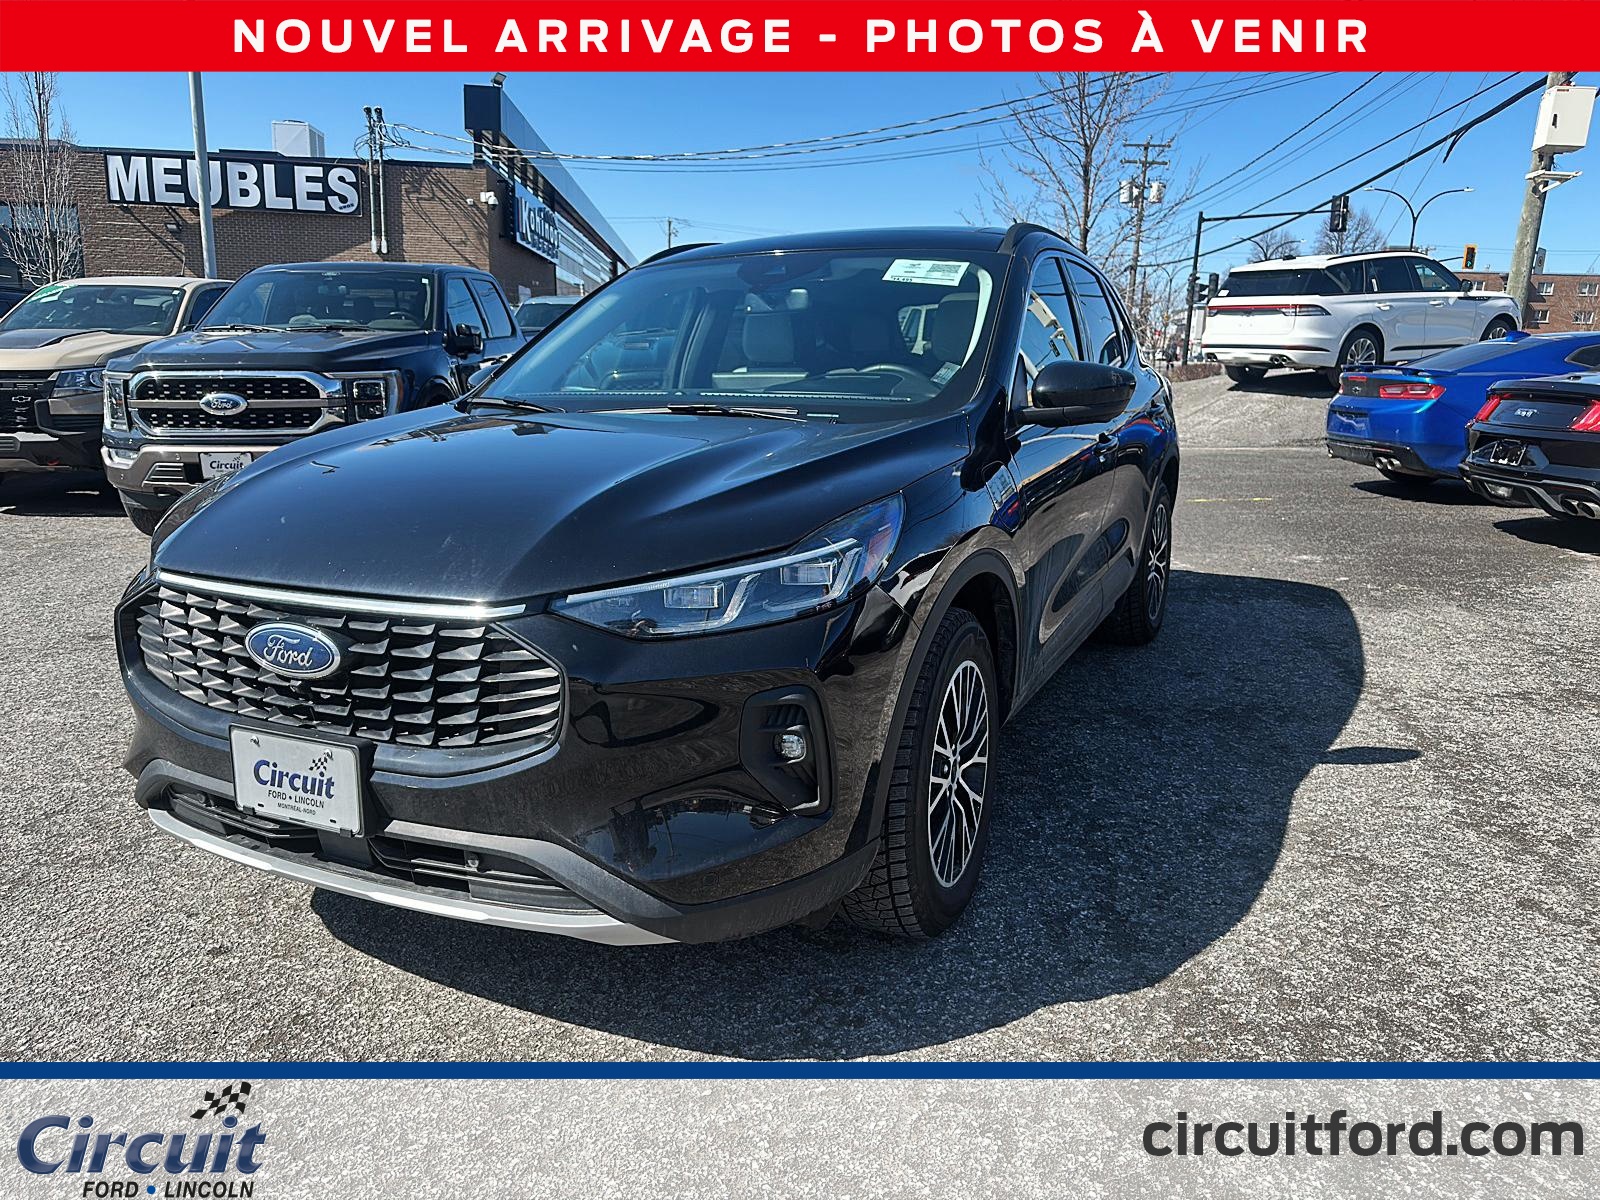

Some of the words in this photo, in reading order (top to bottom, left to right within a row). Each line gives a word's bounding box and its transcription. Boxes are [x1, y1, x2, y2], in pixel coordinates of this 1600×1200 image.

[106, 155, 359, 213] MEUBLES
[263, 633, 314, 669] Ford
[253, 759, 335, 799] Circuit
[267, 789, 287, 801] FORD
[294, 795, 325, 809] LINCOLN
